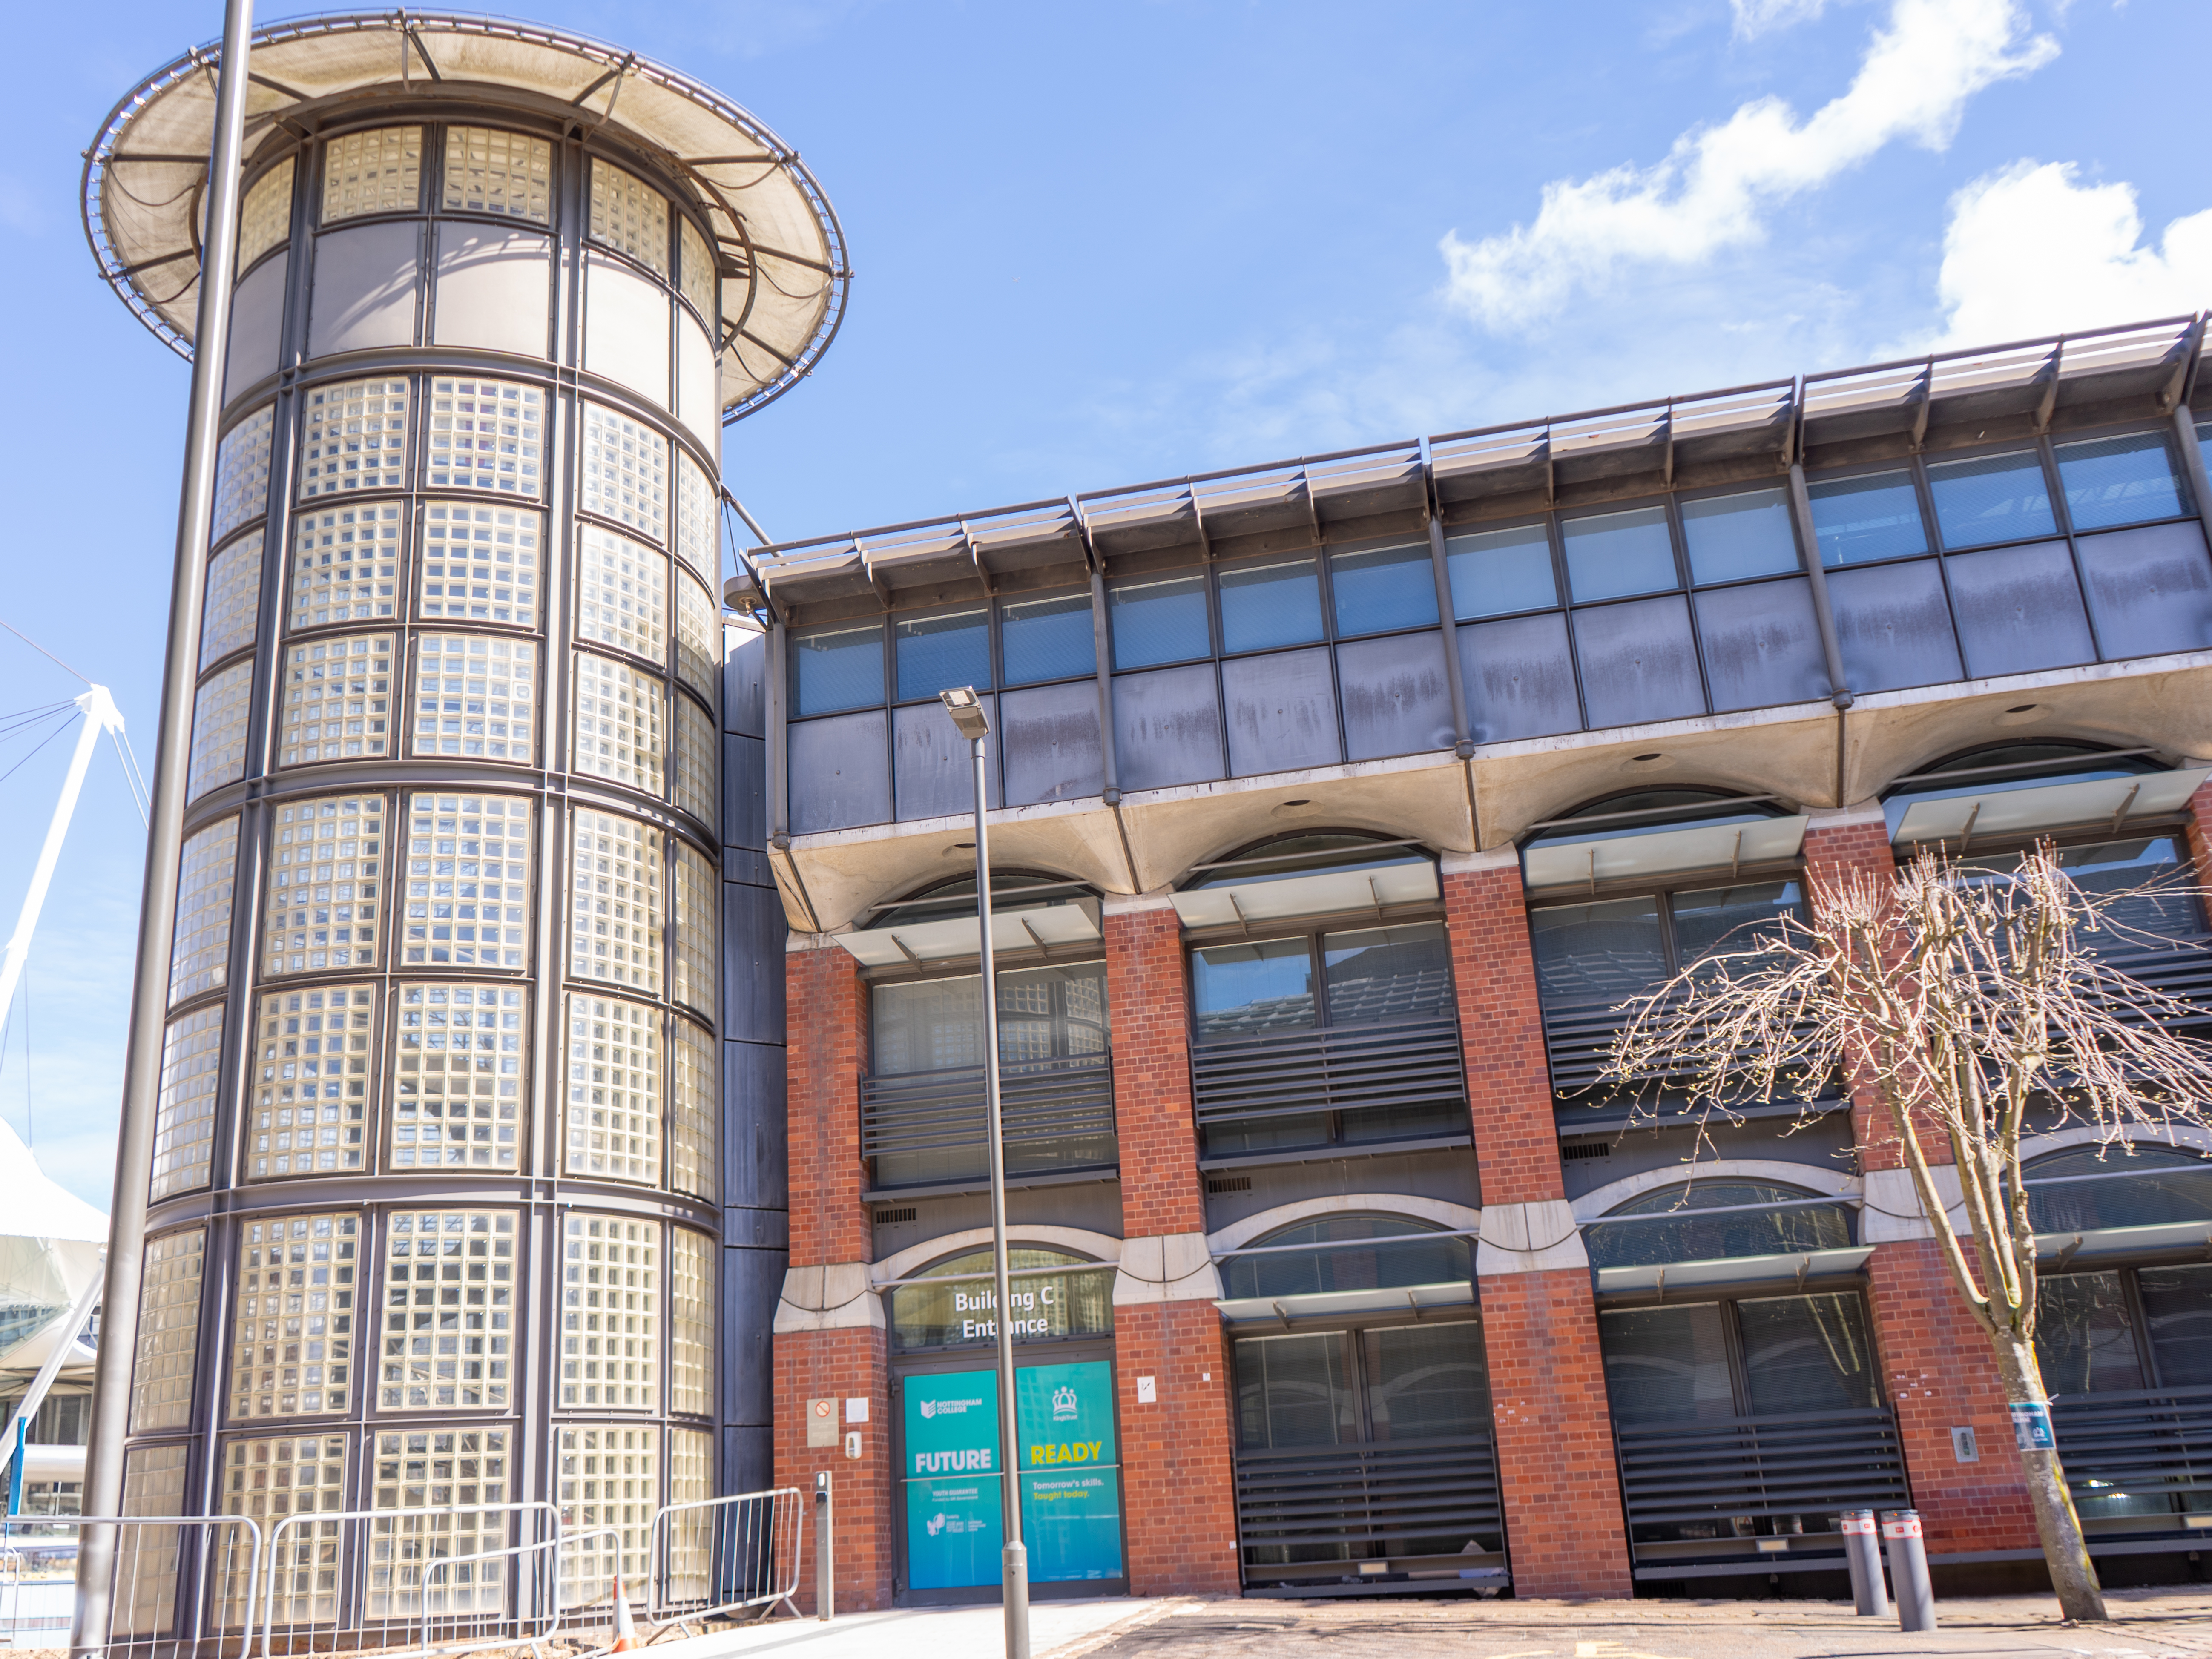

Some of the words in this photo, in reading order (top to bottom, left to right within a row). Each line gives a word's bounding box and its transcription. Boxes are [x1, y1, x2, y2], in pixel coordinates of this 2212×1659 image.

[955, 1290, 1034, 1311] Builng
[1040, 1286, 1054, 1305] C
[963, 1318, 1048, 1338] Entnce
[937, 1398, 982, 1408] NOTTINGHAM
[937, 1406, 967, 1415] COLLEGE
[1031, 1441, 1102, 1464] READY
[916, 1449, 991, 1473] FUTURE
[1033, 1479, 1080, 1490] Tomorrow's
[1082, 1478, 1104, 1487] skills.
[1034, 1491, 1061, 1501] Taught
[1063, 1490, 1089, 1498] today.
